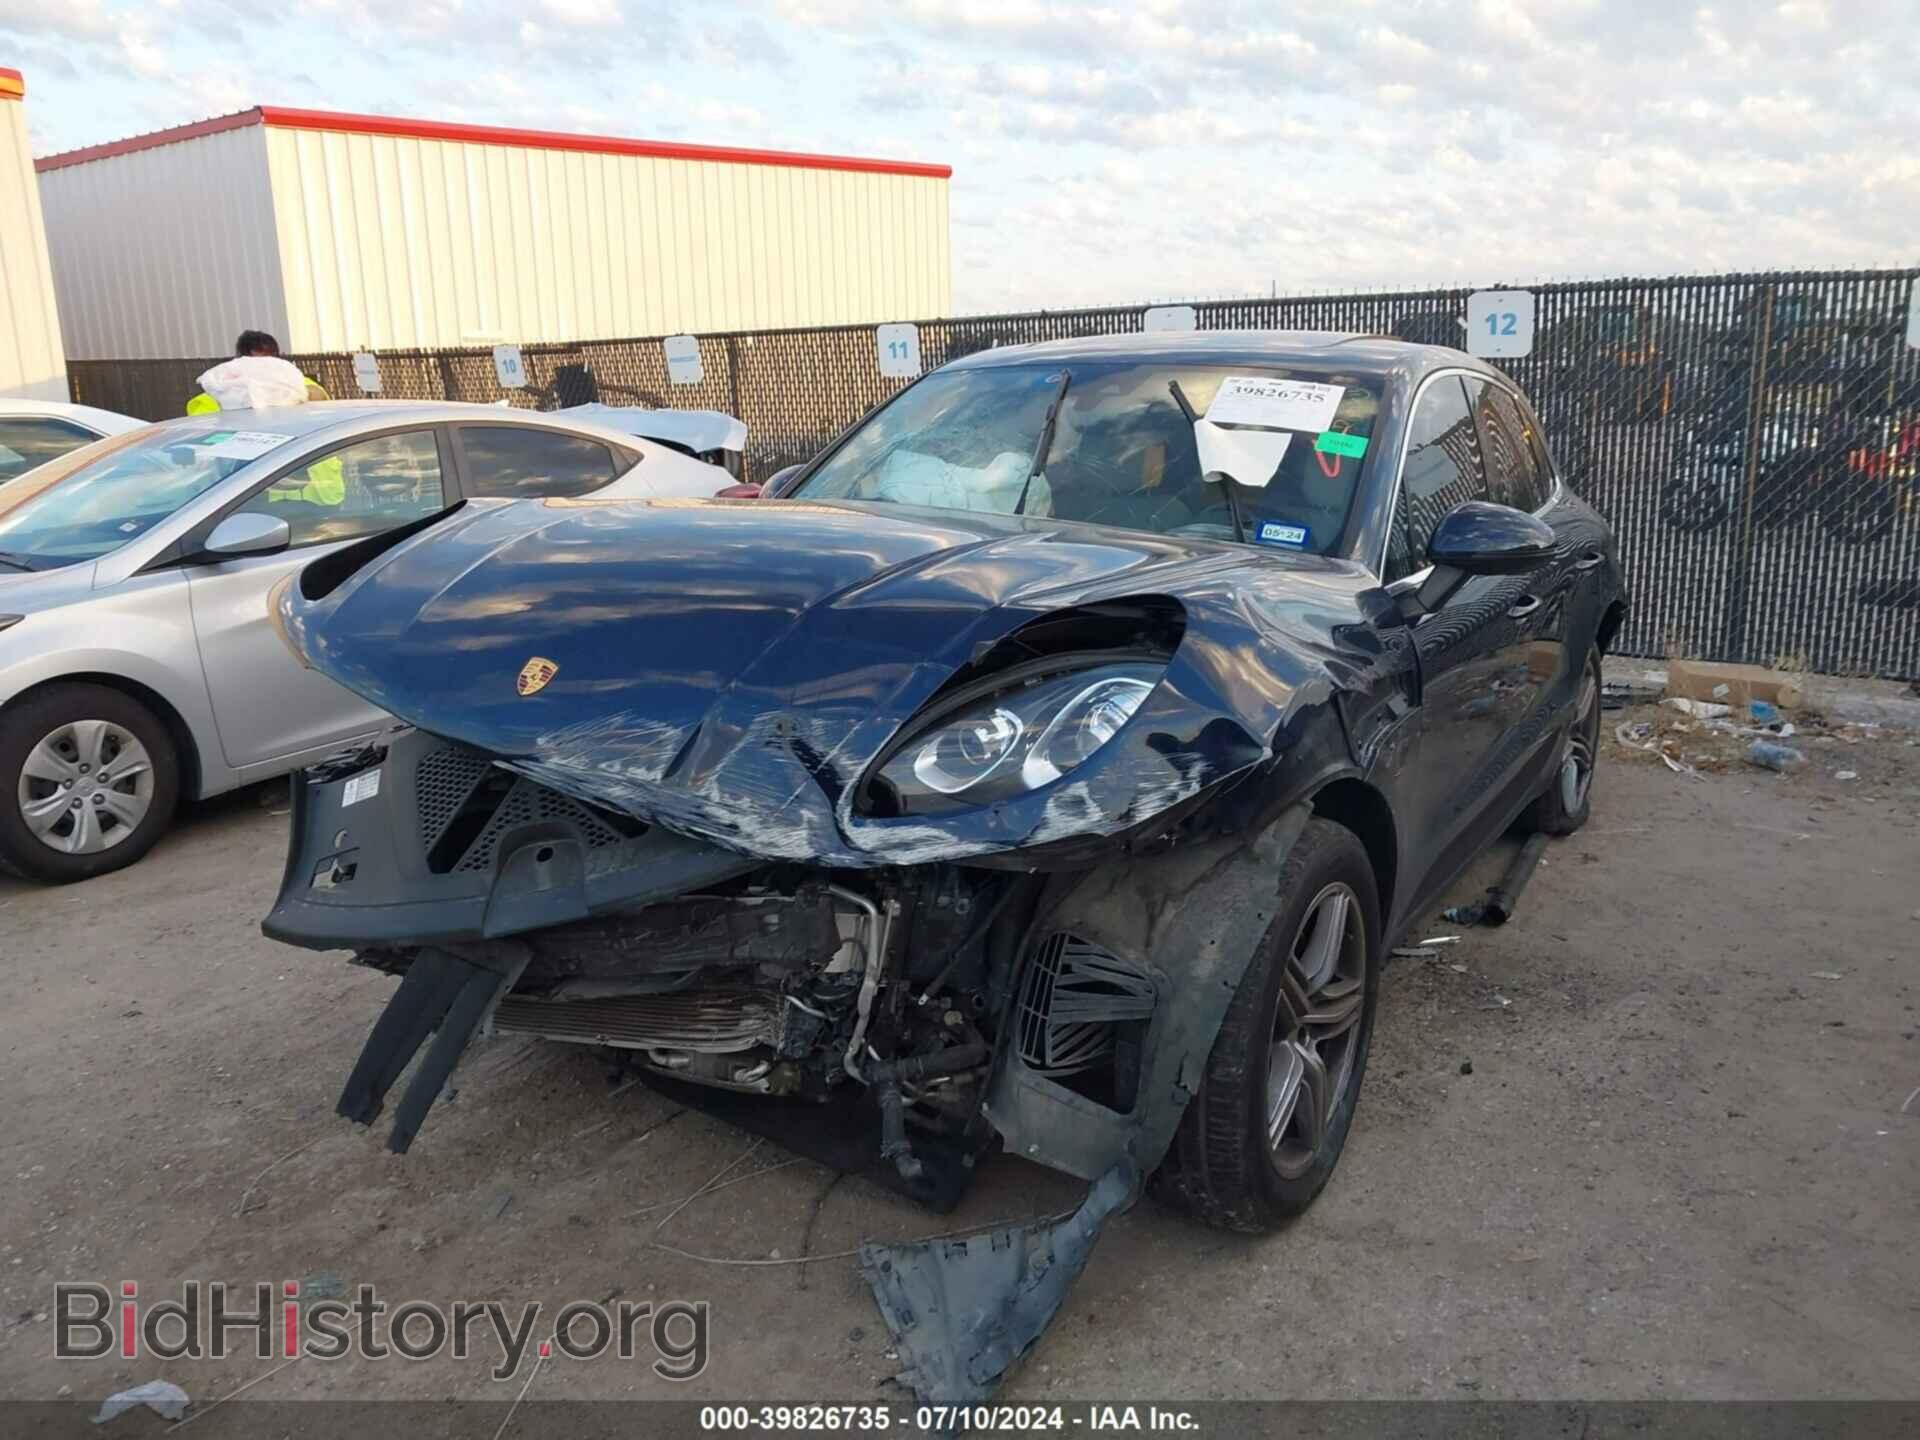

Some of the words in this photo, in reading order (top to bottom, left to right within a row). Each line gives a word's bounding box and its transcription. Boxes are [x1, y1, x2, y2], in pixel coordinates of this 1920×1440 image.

[1485, 313, 1516, 335] 12
[888, 341, 908, 359] 11
[503, 359, 517, 374] 10
[1231, 386, 1326, 402] 39826735
